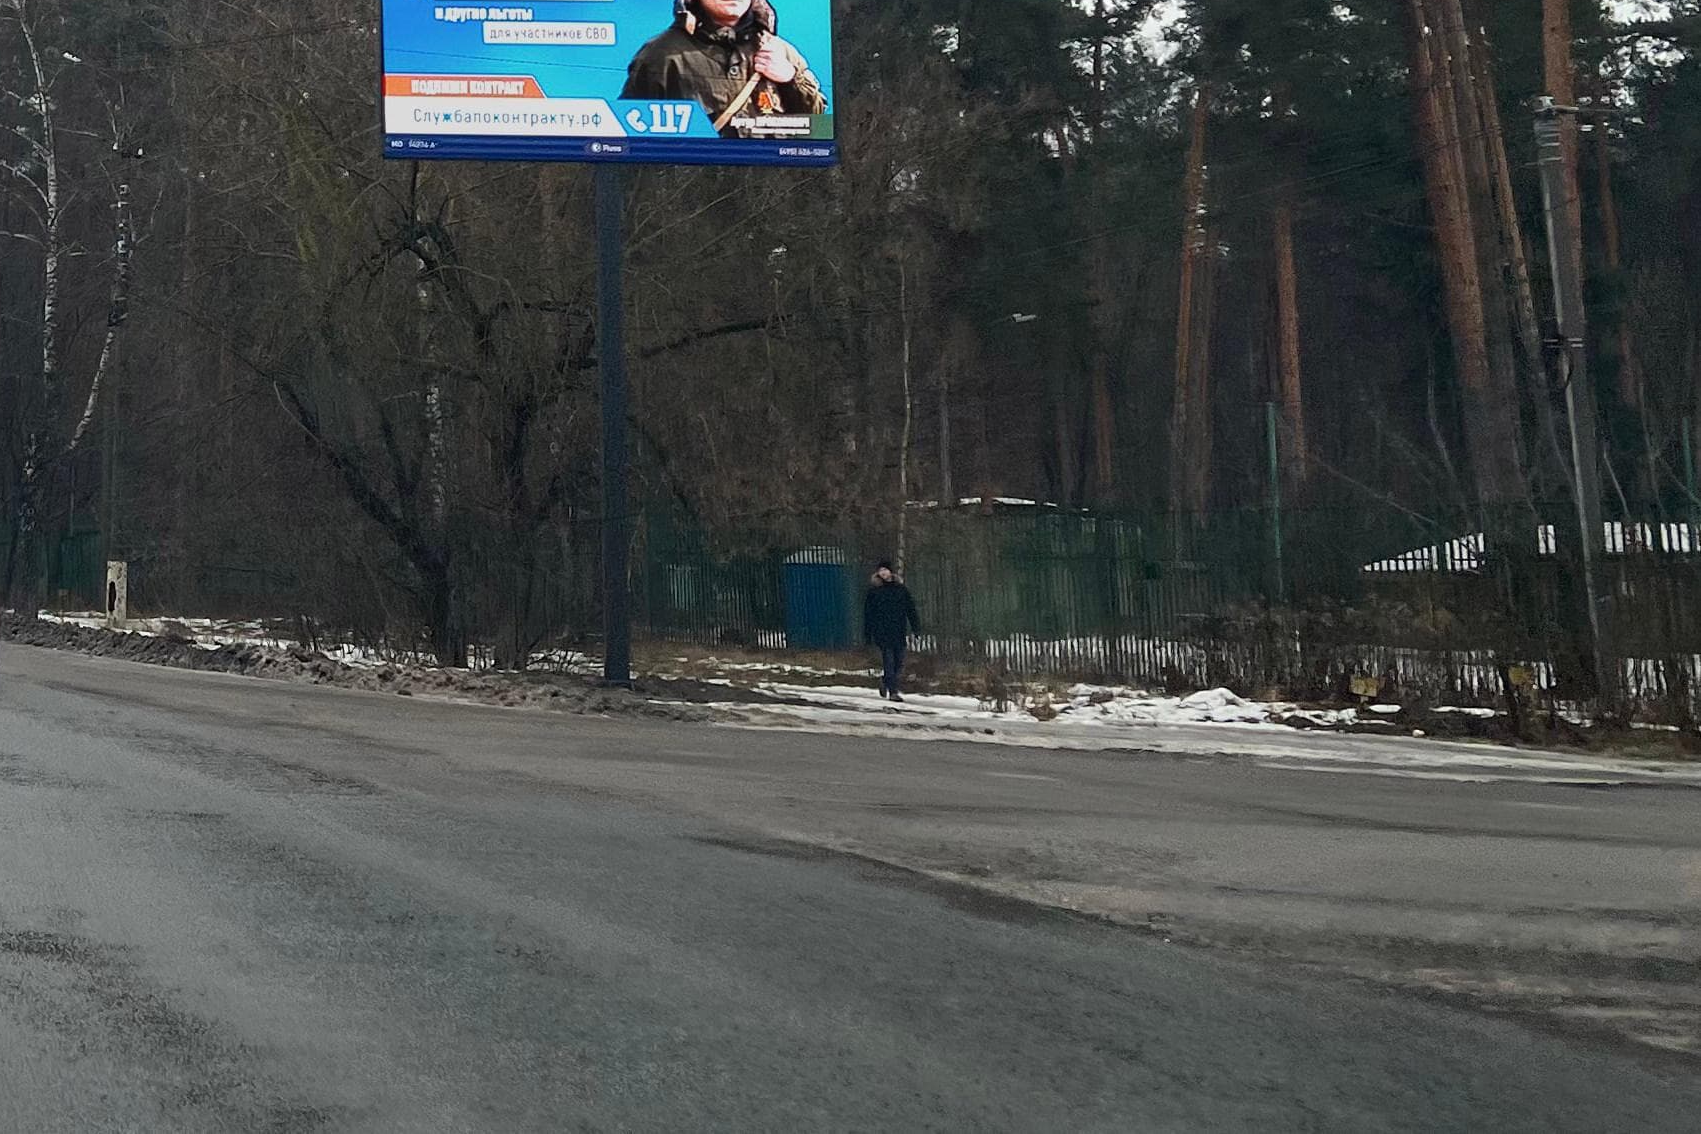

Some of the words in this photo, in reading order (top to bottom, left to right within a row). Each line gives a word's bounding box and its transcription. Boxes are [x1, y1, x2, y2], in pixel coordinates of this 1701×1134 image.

[488, 8, 533, 21] льготы
[489, 29, 511, 40] для
[515, 28, 583, 41] участников
[586, 27, 608, 41] СВО
[413, 108, 602, 127] Службапоконтракту.рф
[649, 103, 692, 133] 117
